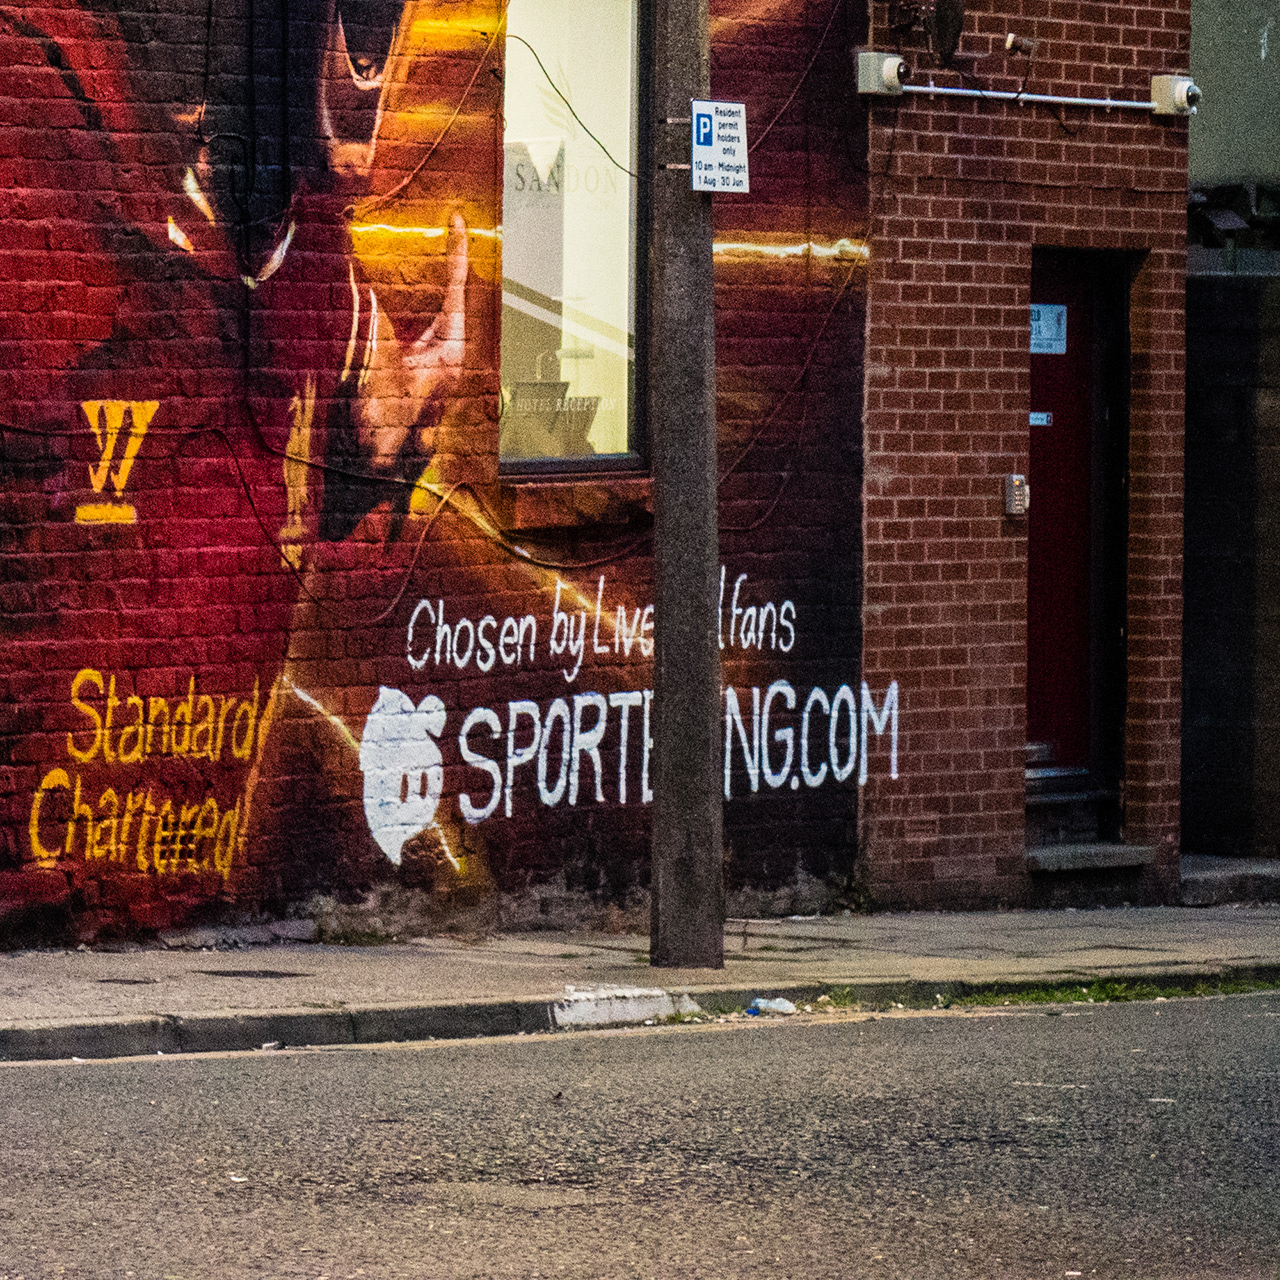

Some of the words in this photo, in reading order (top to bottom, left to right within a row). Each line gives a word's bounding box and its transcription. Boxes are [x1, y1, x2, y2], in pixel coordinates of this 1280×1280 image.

[714, 106, 742, 118] Resident
[718, 121, 739, 131] permit
[716, 133, 741, 143] holders
[722, 146, 736, 157] only
[695, 160, 703, 171] 10
[703, 163, 713, 171] am
[717, 162, 746, 175] Midnight
[514, 162, 618, 194] SANDON
[703, 175, 716, 187] Aug
[731, 178, 743, 187] Jun
[407, 599, 537, 672] Chosen
[550, 576, 586, 682] by
[729, 573, 797, 652] fans
[66, 668, 260, 764] Standard
[29, 768, 243, 880] Chartered
